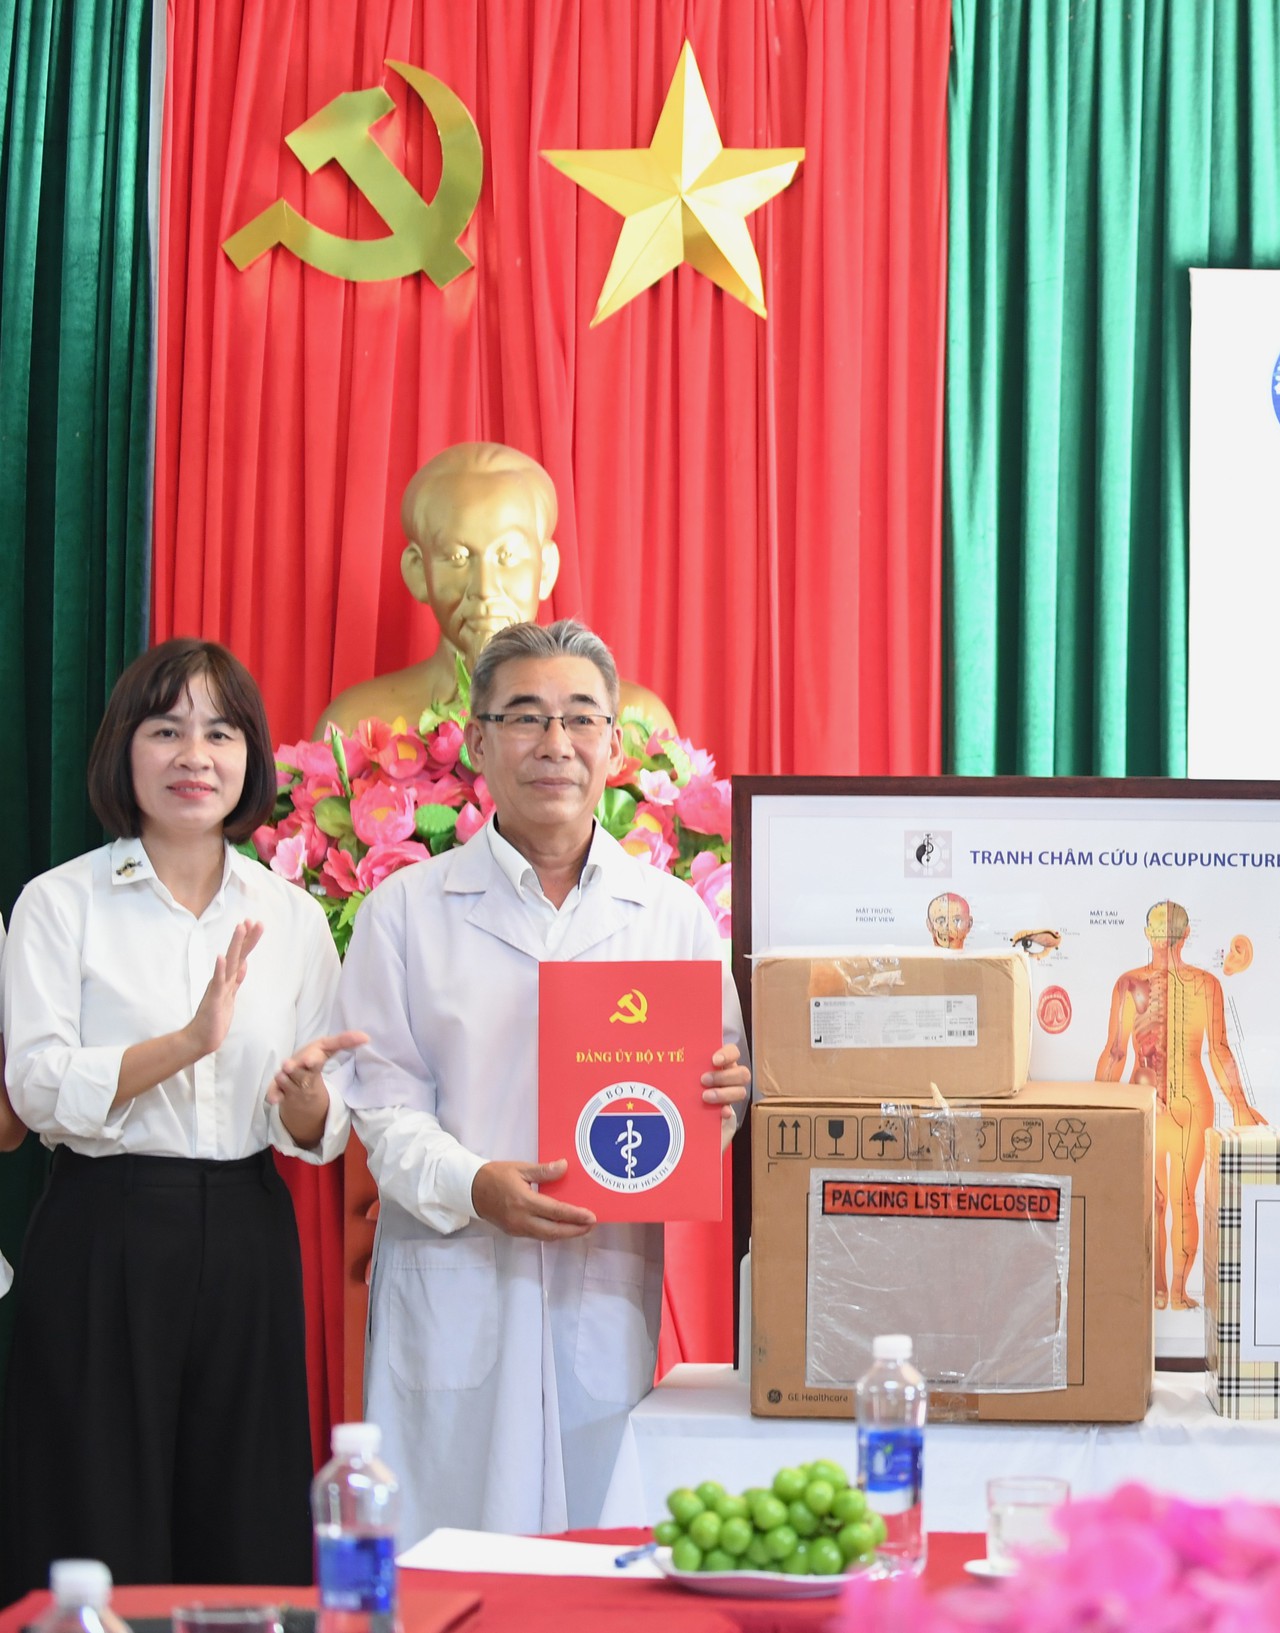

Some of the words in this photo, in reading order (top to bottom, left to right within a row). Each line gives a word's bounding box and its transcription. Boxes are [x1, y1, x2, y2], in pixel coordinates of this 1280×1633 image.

[970, 850, 1033, 865] TRANH
[1038, 848, 1093, 866] CHÂM
[1098, 848, 1138, 866] CỨU
[576, 1048, 612, 1063] ĐẢNG
[636, 1048, 654, 1065] BỘ
[656, 1051, 665, 1063] Y
[668, 1046, 685, 1063] TẾ
[629, 1085, 636, 1094] Y
[591, 1168, 626, 1190] MINISTRY
[641, 1165, 669, 1188] HEALTH
[831, 1189, 909, 1209] PACKING
[914, 1191, 951, 1209] LIST
[957, 1193, 1051, 1213] ENCLOSED
[802, 1394, 848, 1402] Healthcare
